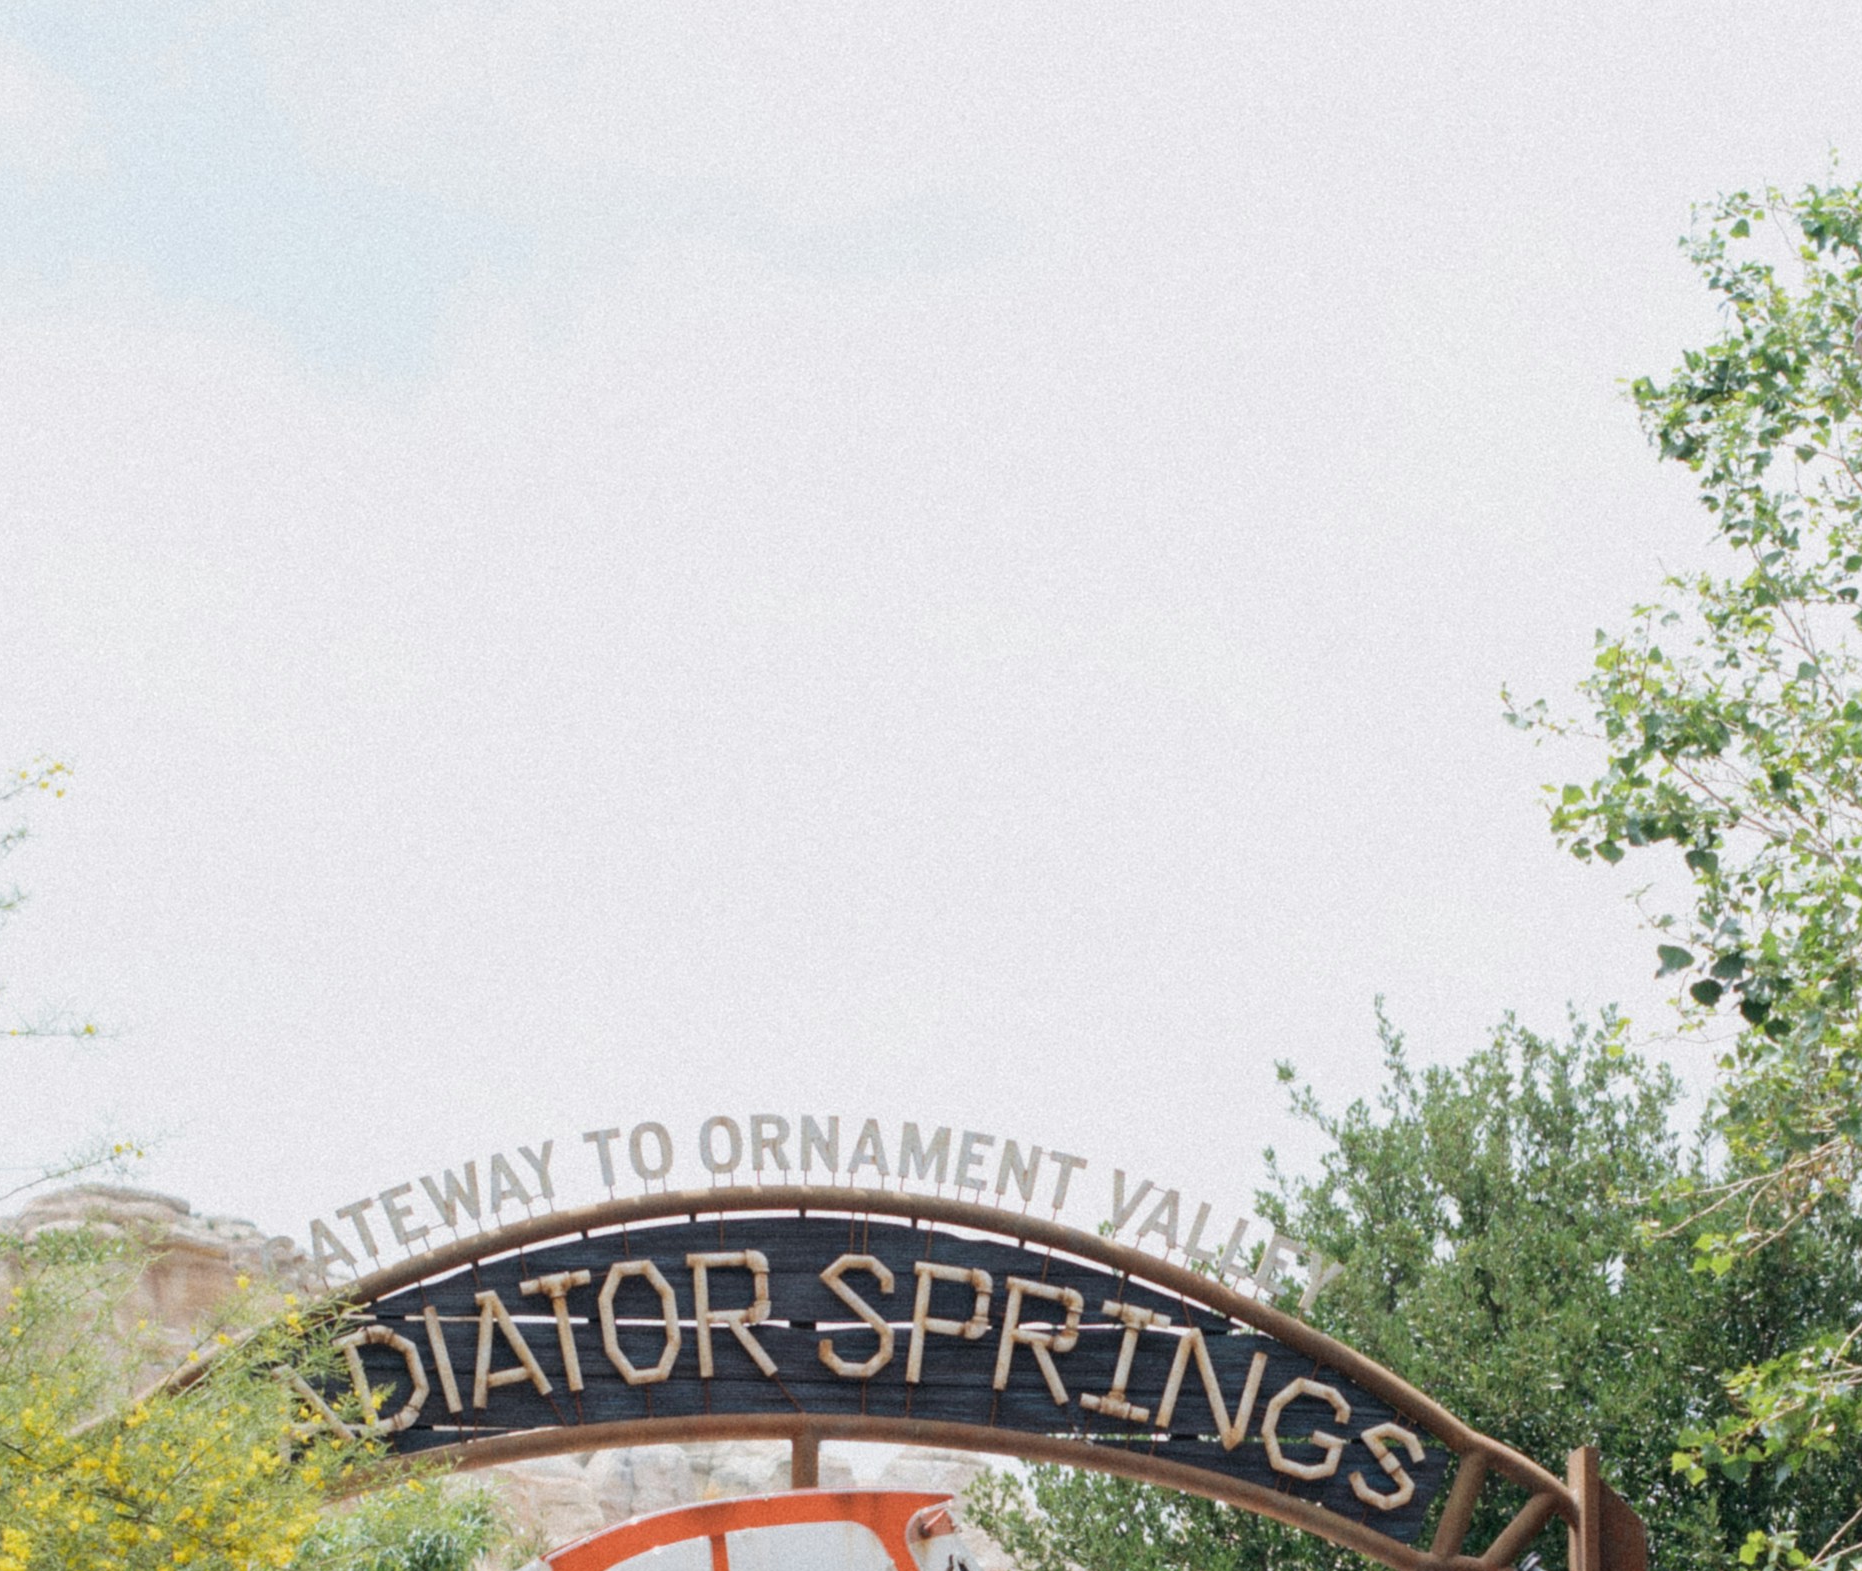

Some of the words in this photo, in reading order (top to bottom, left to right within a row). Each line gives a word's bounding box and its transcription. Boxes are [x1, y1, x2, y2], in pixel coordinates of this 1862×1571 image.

[582, 1120, 674, 1185] TO
[699, 1113, 1088, 1209] ORNAMENT
[1111, 1167, 1344, 1311] VALLEY
[818, 1253, 1427, 1511] SPRINGS
